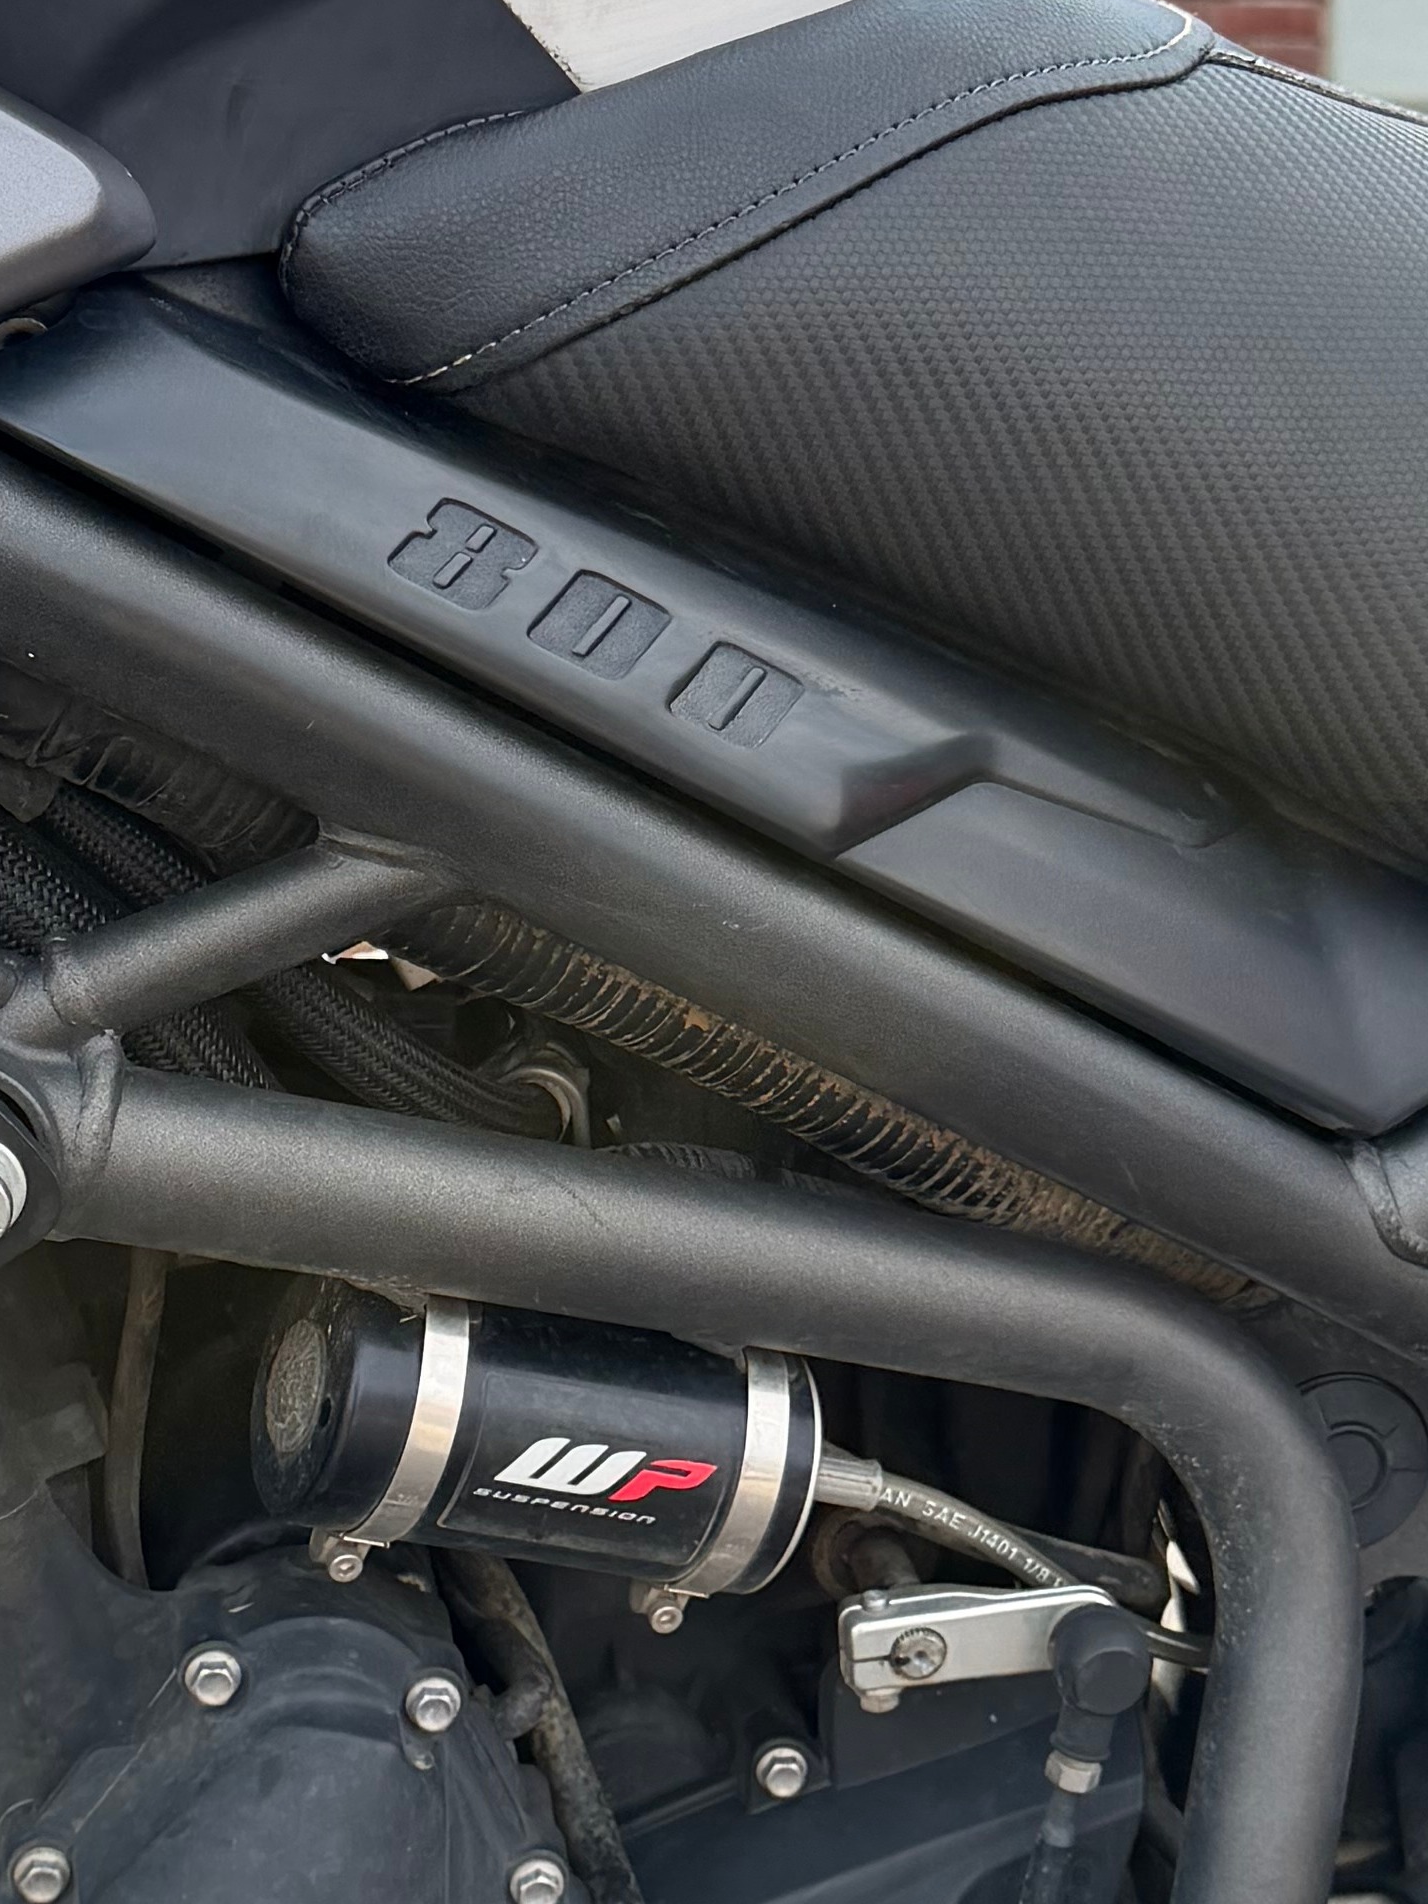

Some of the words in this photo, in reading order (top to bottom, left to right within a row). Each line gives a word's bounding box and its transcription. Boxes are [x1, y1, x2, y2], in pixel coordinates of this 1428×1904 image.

[386, 496, 806, 750] 800
[493, 1436, 719, 1502] WP
[472, 1486, 657, 1525] SUSPENSION
[922, 1500, 967, 1530] SAE
[967, 1525, 1019, 1561] J1401
